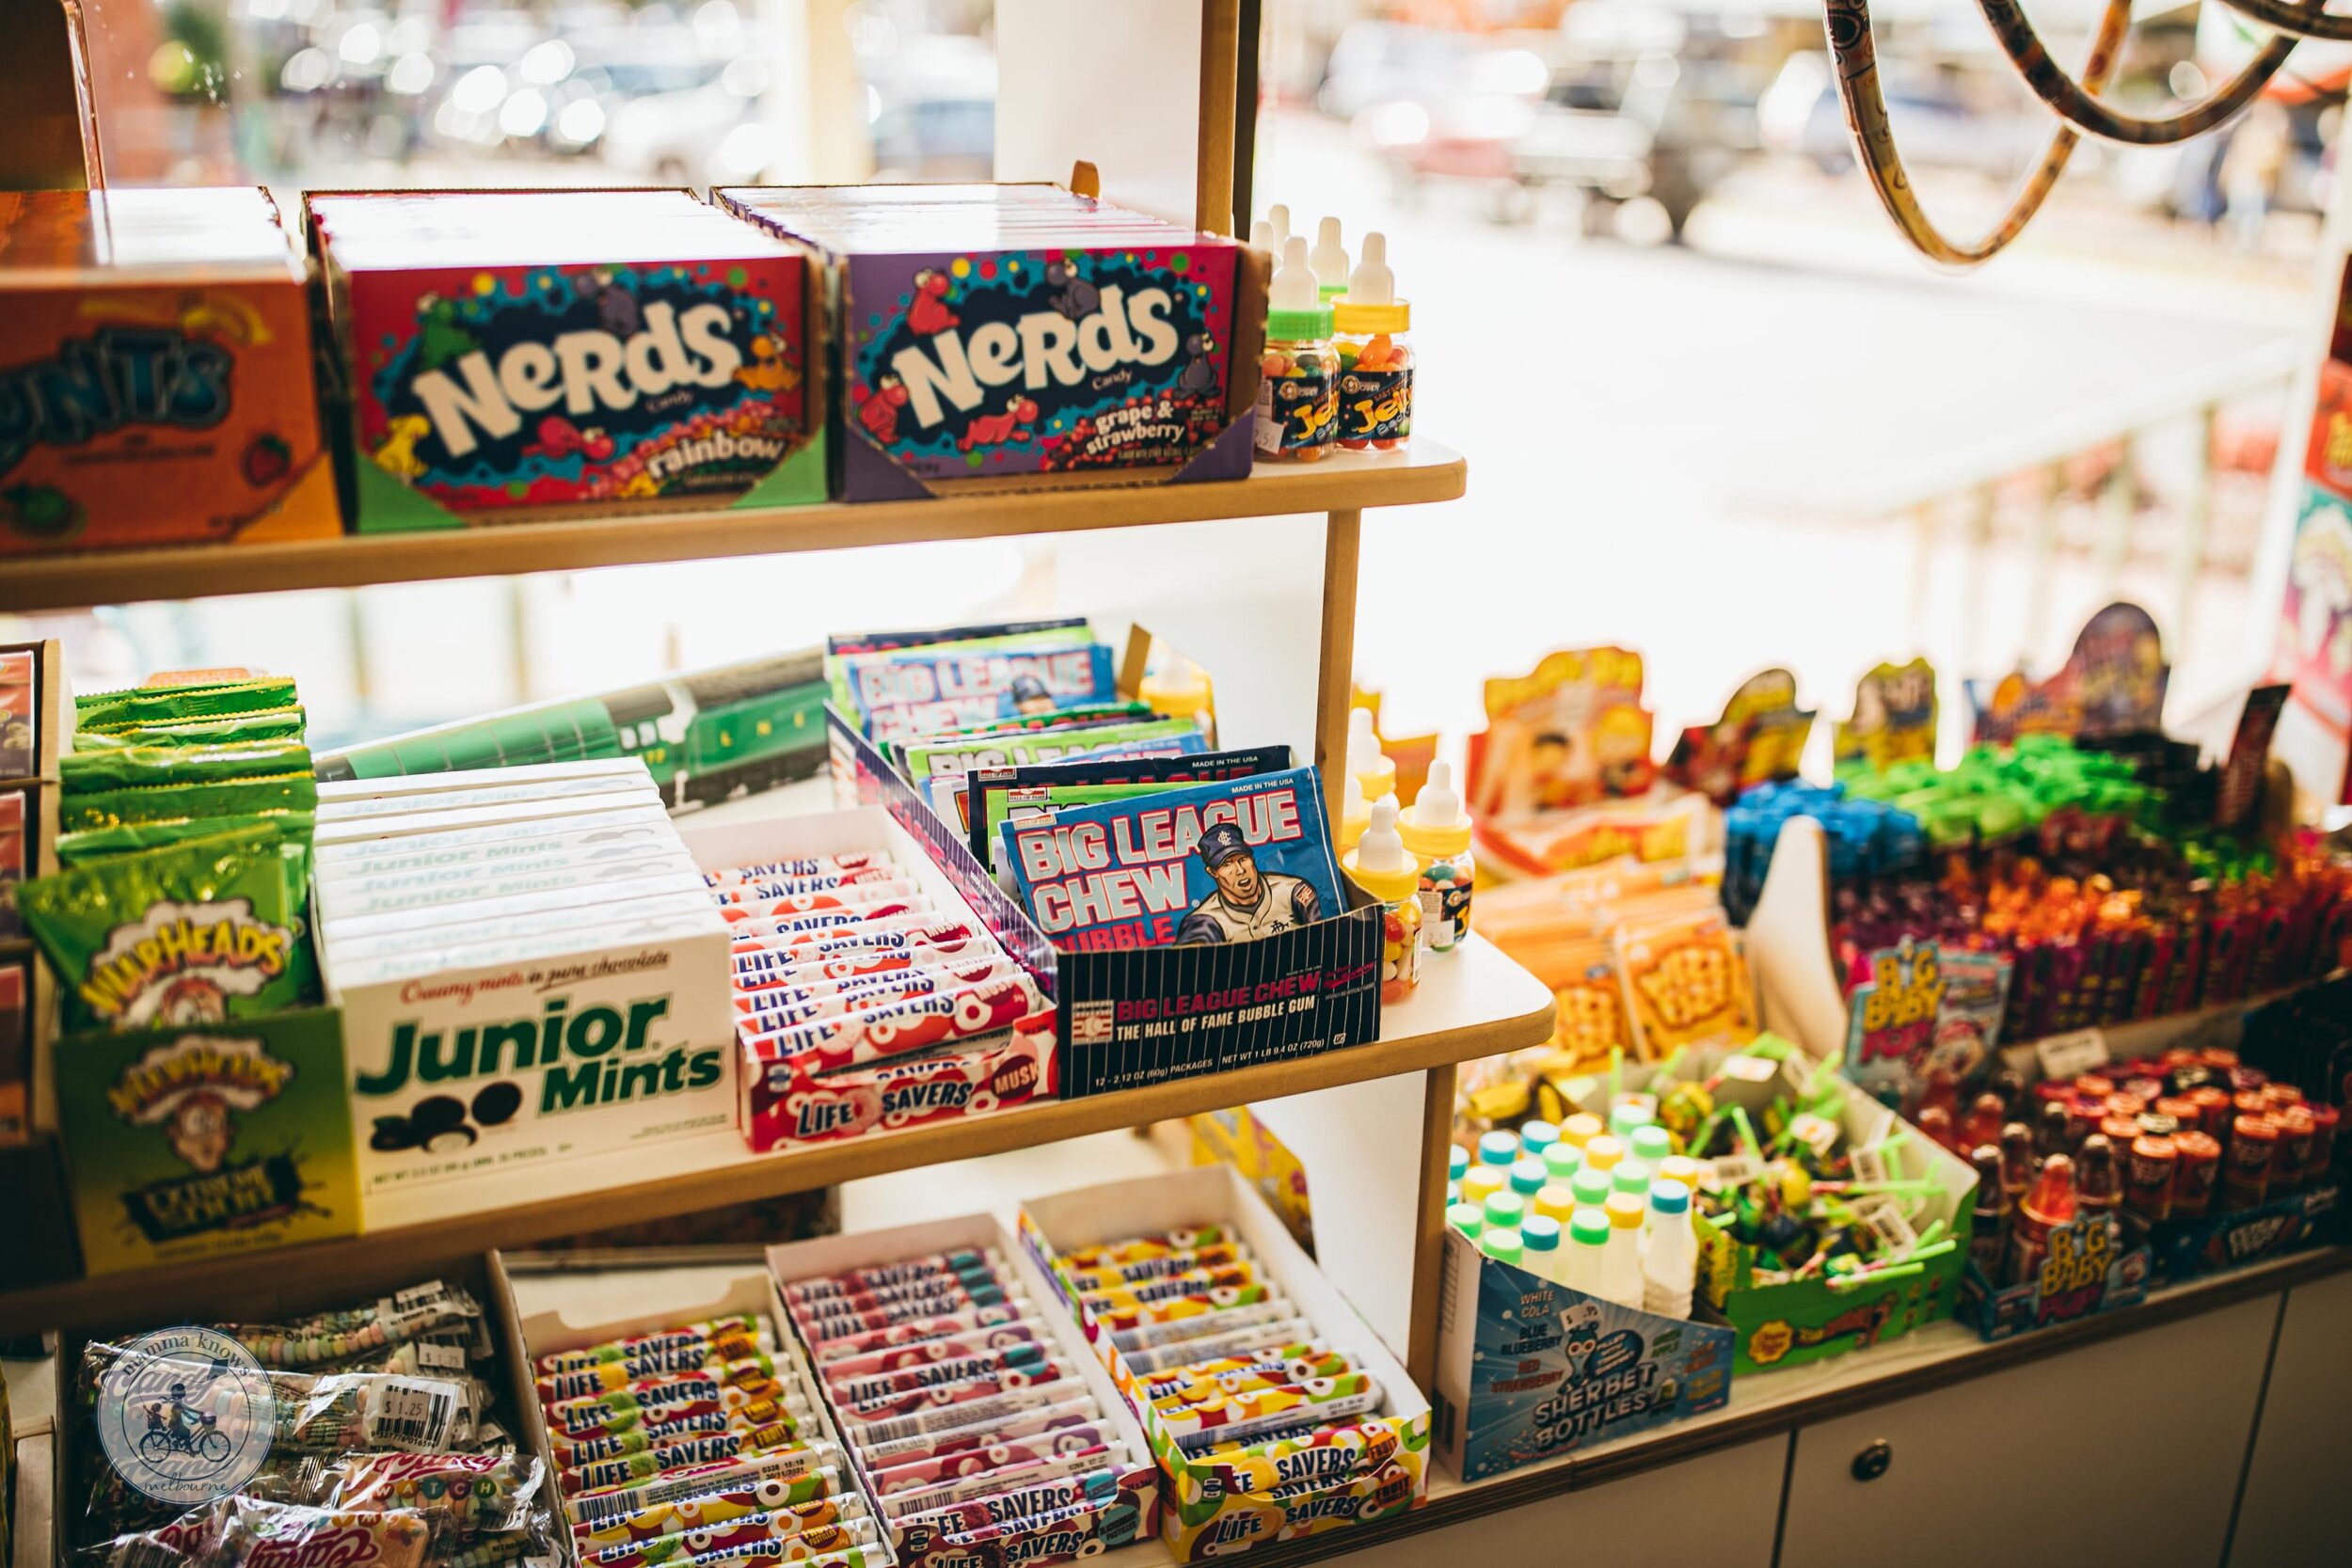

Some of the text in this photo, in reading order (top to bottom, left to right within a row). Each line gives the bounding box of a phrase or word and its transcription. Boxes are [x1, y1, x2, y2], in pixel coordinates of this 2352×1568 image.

[1092, 368, 1132, 390] Candy
[1086, 421, 1185, 455] strawberry
[1095, 404, 1153, 436] grape
[1156, 400, 1174, 420] &
[648, 429, 785, 478] rainbow
[857, 649, 1097, 709] BIG LEAGUE
[1191, 760, 1214, 768] MADE
[1226, 757, 1240, 766] THE
[1242, 755, 1259, 764] USA
[1232, 785, 1254, 794] MADE
[1264, 782, 1278, 790] THE
[1279, 778, 1294, 786] USA
[1016, 787, 1304, 882] BIG LEAGUE
[348, 838, 563, 877] Junior Mints
[1031, 862, 1188, 935] CHEW
[478, 971, 525, 992] mints
[526, 965, 544, 985] in
[589, 950, 671, 976] chocolate
[1117, 998, 1158, 1022] BIG
[1163, 985, 1251, 1018] LEAGUE
[1253, 971, 1322, 1003] CHEW
[1117, 994, 1315, 1042] THE HALL OF FAME BUBBLE GUM
[352, 992, 674, 1098] Junior
[778, 1022, 835, 1056] LIFE
[537, 1041, 725, 1117] Mints
[993, 1063, 1039, 1095] MUSK
[1095, 1077, 1105, 1087] 12
[1134, 1069, 1145, 1080] OZ
[1169, 1058, 1214, 1074] PACKAGES
[1221, 1053, 1237, 1065] NET
[1240, 1051, 1252, 1061] WT
[1261, 1048, 1272, 1057] LB
[1273, 1044, 1286, 1055] 9.4
[1287, 1041, 1299, 1053] OZ
[1299, 1038, 1325, 1052] (720g)
[797, 1080, 975, 1138] LIFE SAVERS
[1520, 1290, 1555, 1306] WHITE
[1520, 1305, 1550, 1318] COLA
[554, 1371, 604, 1402] LIFE
[625, 1348, 704, 1380] SAVERS
[1532, 1361, 1660, 1428] SHERBET
[384, 1400, 423, 1417] $ 1.25
[1534, 1389, 1648, 1452] BOTTLES
[571, 1410, 728, 1467] LIFE SAVERS
[580, 1460, 635, 1491] LIFE
[654, 1435, 742, 1470] SAVERS
[1276, 1447, 1358, 1483] SAVERS
[376, 1481, 492, 1497] WATCH
[987, 1486, 1073, 1524] SAVERS
[1216, 1495, 1361, 1545] LIFE SAVERS
[1004, 1530, 1085, 1563] SAVERS
